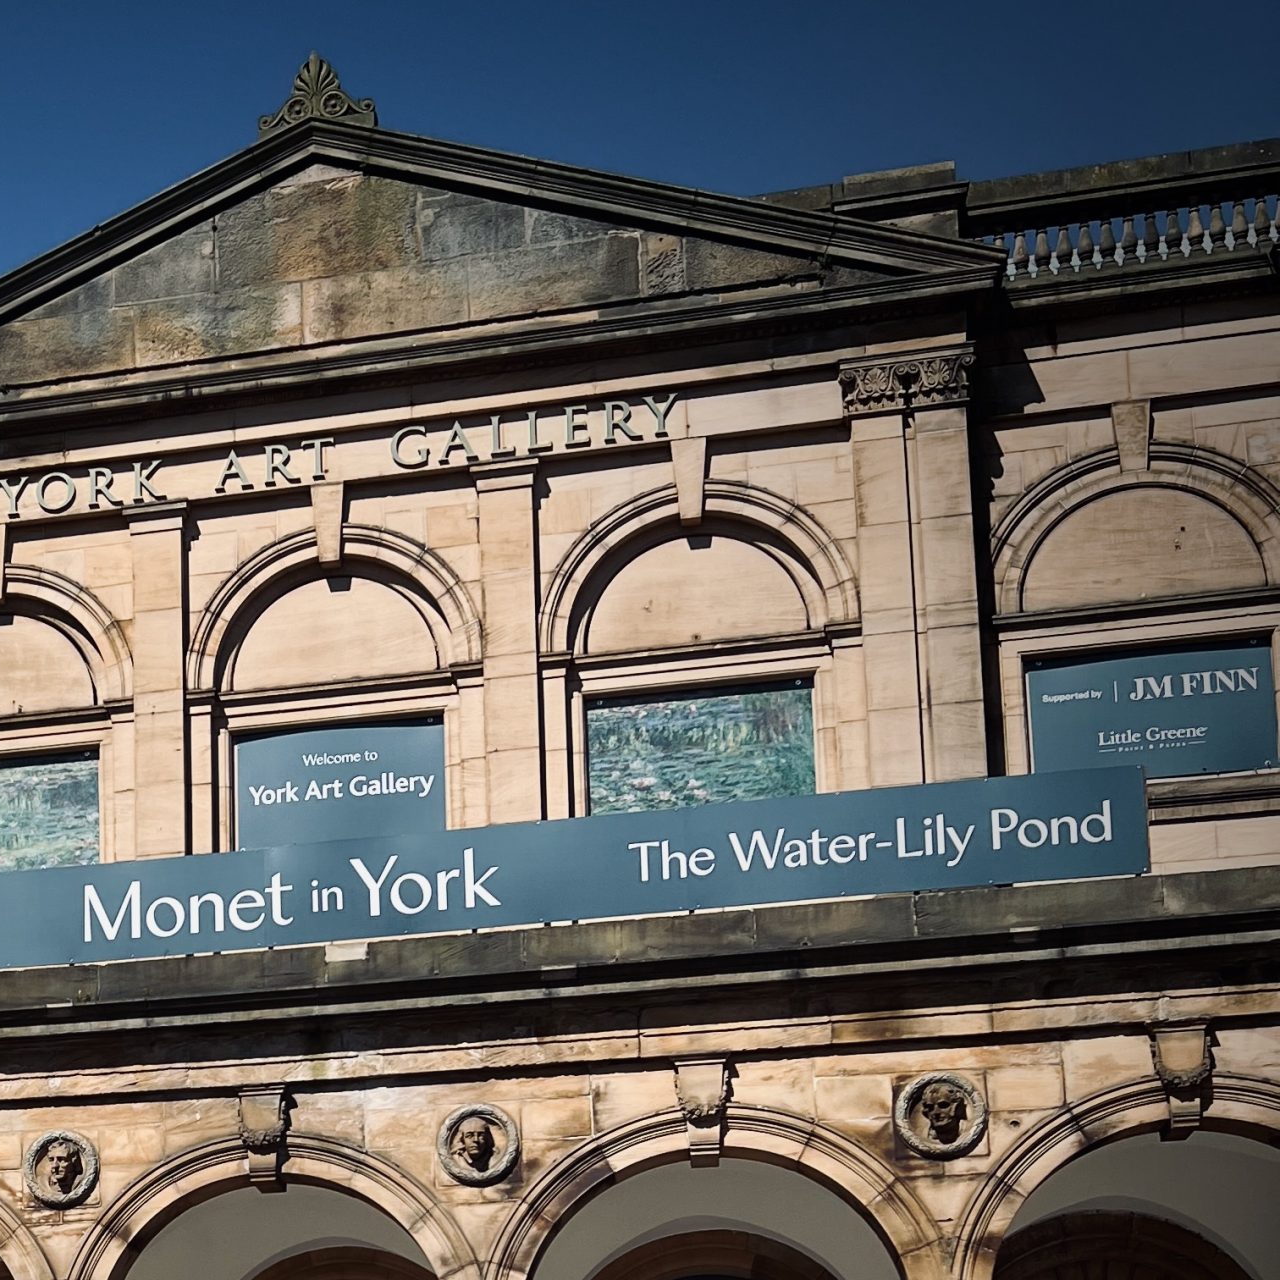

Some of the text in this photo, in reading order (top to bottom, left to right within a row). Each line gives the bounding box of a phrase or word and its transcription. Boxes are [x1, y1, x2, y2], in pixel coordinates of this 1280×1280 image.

[214, 436, 335, 494] ART
[390, 392, 679, 469] GALLERY
[1042, 689, 1103, 703] Supported by
[1130, 667, 1260, 701] JM FINN
[1098, 727, 1208, 746] Little Greene
[302, 750, 378, 766] Welcome to
[248, 772, 435, 806] York Art Gallery
[83, 872, 295, 943] Monet
[311, 880, 345, 914] in
[349, 847, 503, 918] York
[628, 840, 717, 882] The
[728, 813, 976, 872] Water-Lily
[991, 799, 1114, 851] Pond
